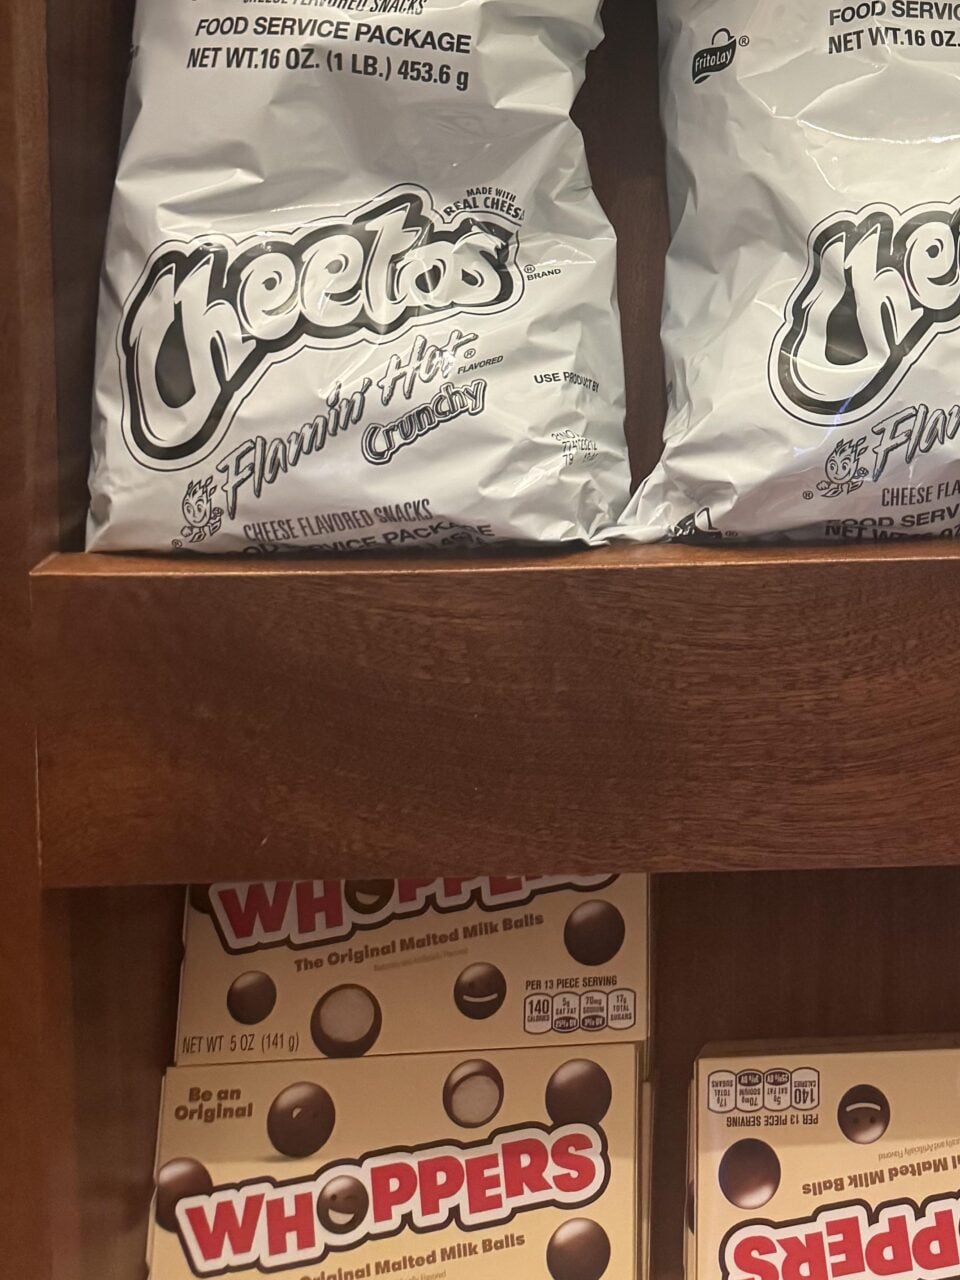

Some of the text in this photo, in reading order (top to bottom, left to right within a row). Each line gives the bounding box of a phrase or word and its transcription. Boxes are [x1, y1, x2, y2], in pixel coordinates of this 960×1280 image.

[829, 0, 886, 26] FOOD
[195, 16, 472, 54] FOOD SERVICE PACKAGE
[828, 28, 865, 55] NET
[868, 26, 926, 47] WT.16
[186, 47, 470, 91] NET WT.16 OZ. (1 LB.) 453.6 g
[695, 48, 732, 72] FritoLay
[466, 187, 517, 202] MADE WITH
[526, 268, 561, 281] BRAND
[120, 190, 523, 463] Cheetos
[457, 355, 504, 375] FLAVORED
[362, 378, 488, 465] Crunchy
[243, 498, 432, 542] CHEESE FLAVORED SNACKS
[294, 957, 324, 973] The
[327, 940, 397, 965] Original
[399, 928, 460, 952] Malted
[463, 922, 500, 940] Milk
[502, 912, 545, 932] Balls
[528, 999, 550, 1015] 140
[182, 1032, 300, 1054] NET WT 5 OZ (141 g)
[189, 1086, 242, 1103] Be an
[794, 1088, 816, 1105] 140
[174, 1101, 253, 1124] Original
[726, 1113, 819, 1128] PER 13 PIECE SERVING
[888, 1156, 949, 1177] Malted
[802, 1176, 846, 1196] Balls
[847, 1169, 885, 1189] Milk
[185, 1133, 597, 1262] WHOPPERS
